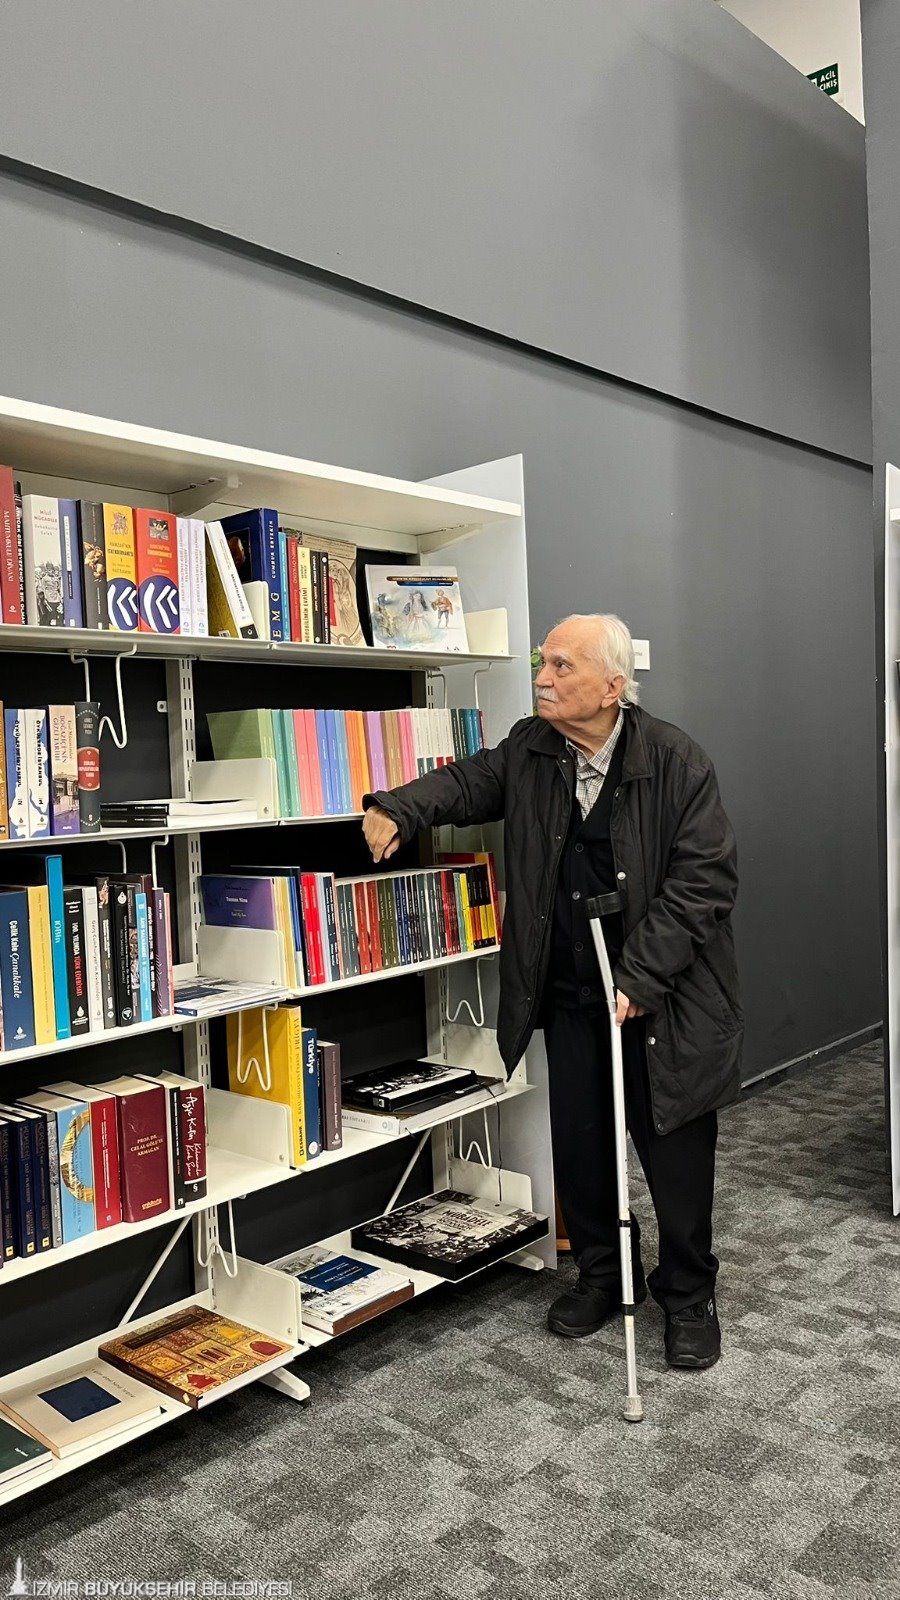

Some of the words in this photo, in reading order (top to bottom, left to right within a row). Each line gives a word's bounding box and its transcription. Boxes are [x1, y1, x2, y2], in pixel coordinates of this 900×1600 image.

[9, 920, 18, 936] Çelik
[10, 938, 19, 951] Kale
[10, 952, 22, 998] Çanakkale
